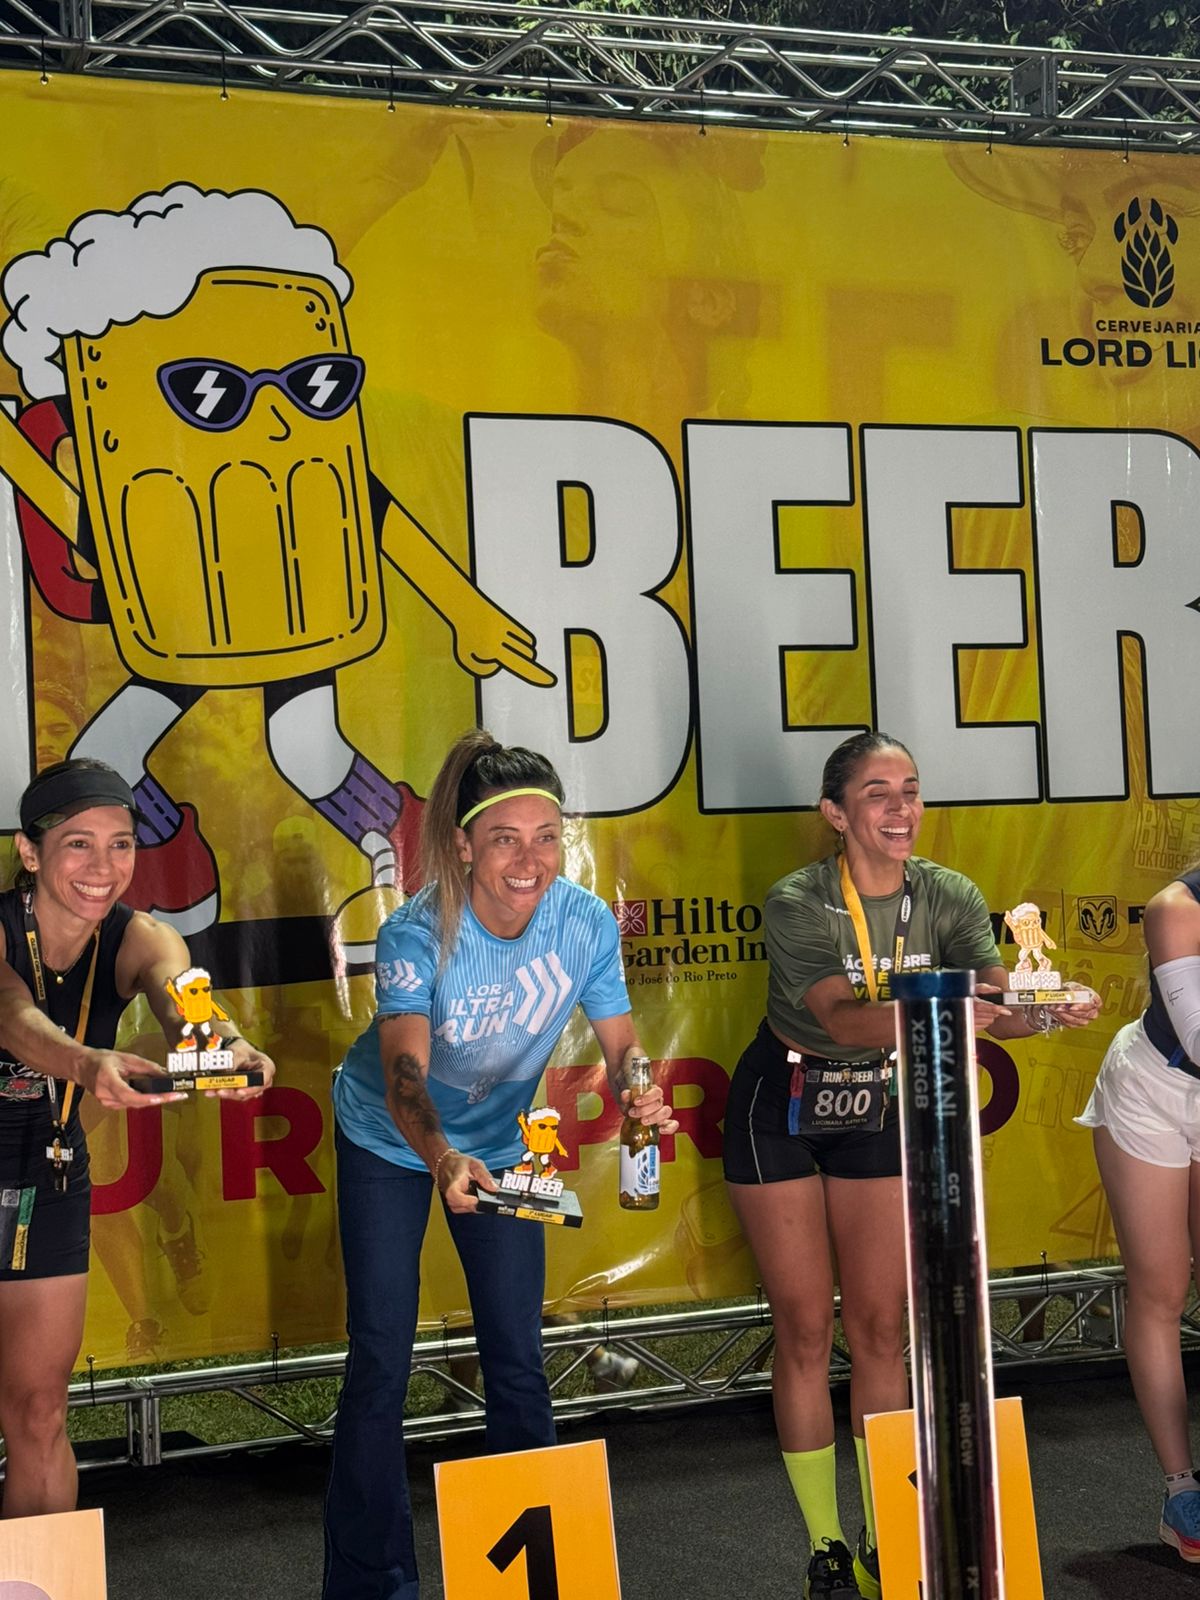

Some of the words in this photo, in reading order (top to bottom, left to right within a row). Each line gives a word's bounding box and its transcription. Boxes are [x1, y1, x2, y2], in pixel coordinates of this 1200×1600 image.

[1096, 320, 1200, 334] CERVEJARIA
[1041, 338, 1152, 368] LORD
[1166, 341, 1200, 369] LI
[464, 412, 1200, 817] BEER
[652, 897, 764, 936] Hilto
[621, 938, 729, 967] Garden
[735, 936, 769, 962] In
[638, 974, 663, 985] José
[684, 971, 703, 983] Rio
[707, 970, 737, 981] Preto
[167, 1053, 197, 1072] RUN
[200, 1050, 233, 1071] BEER
[912, 1019, 929, 1110] X25-RGB
[822, 1071, 842, 1083] RUN
[814, 1089, 872, 1117] 800
[502, 1173, 531, 1191] RUN
[531, 1177, 564, 1197] BEER
[947, 1172, 961, 1208] CCT
[953, 1285, 966, 1315] HSI
[959, 1402, 975, 1468] RGBCW
[486, 1504, 560, 1600] 1
[966, 1566, 980, 1590] FX
